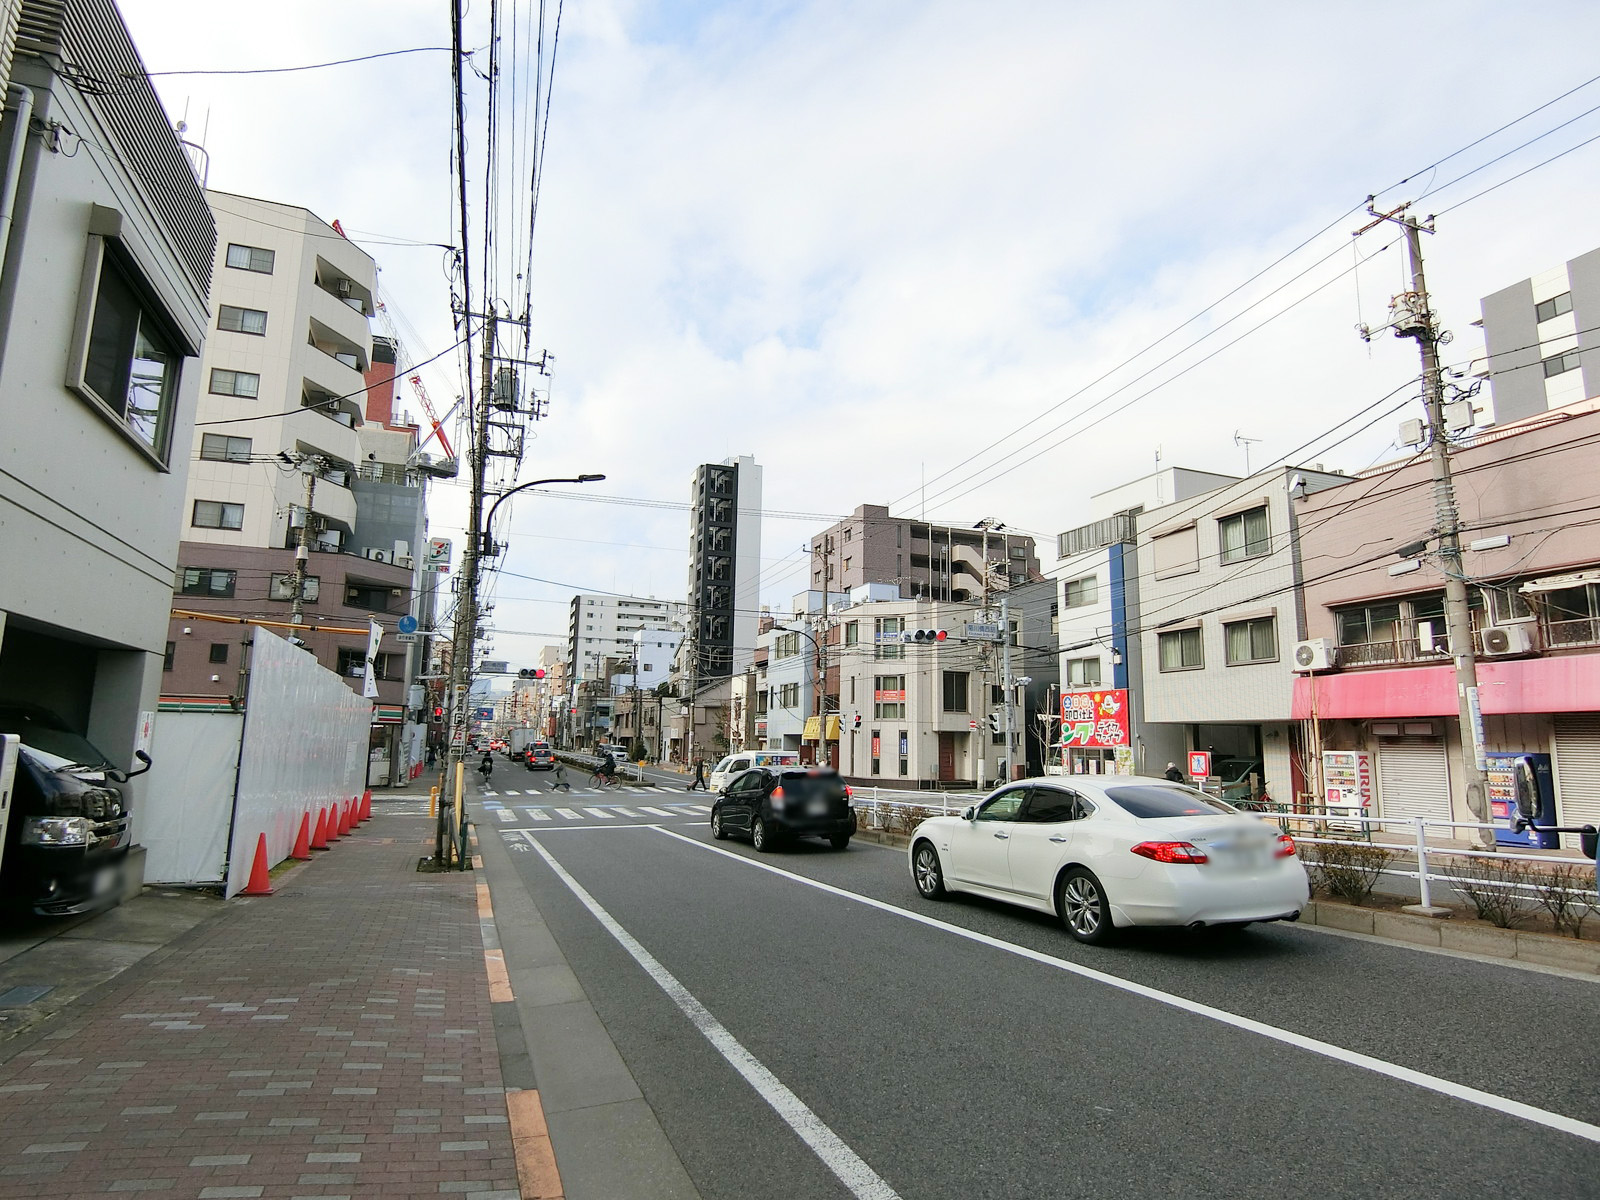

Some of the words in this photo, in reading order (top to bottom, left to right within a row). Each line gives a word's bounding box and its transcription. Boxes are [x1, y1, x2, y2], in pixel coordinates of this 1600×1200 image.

[1061, 722, 1095, 745] ング
[1098, 722, 1119, 733] テイク
[1358, 755, 1372, 807] KIRIN
